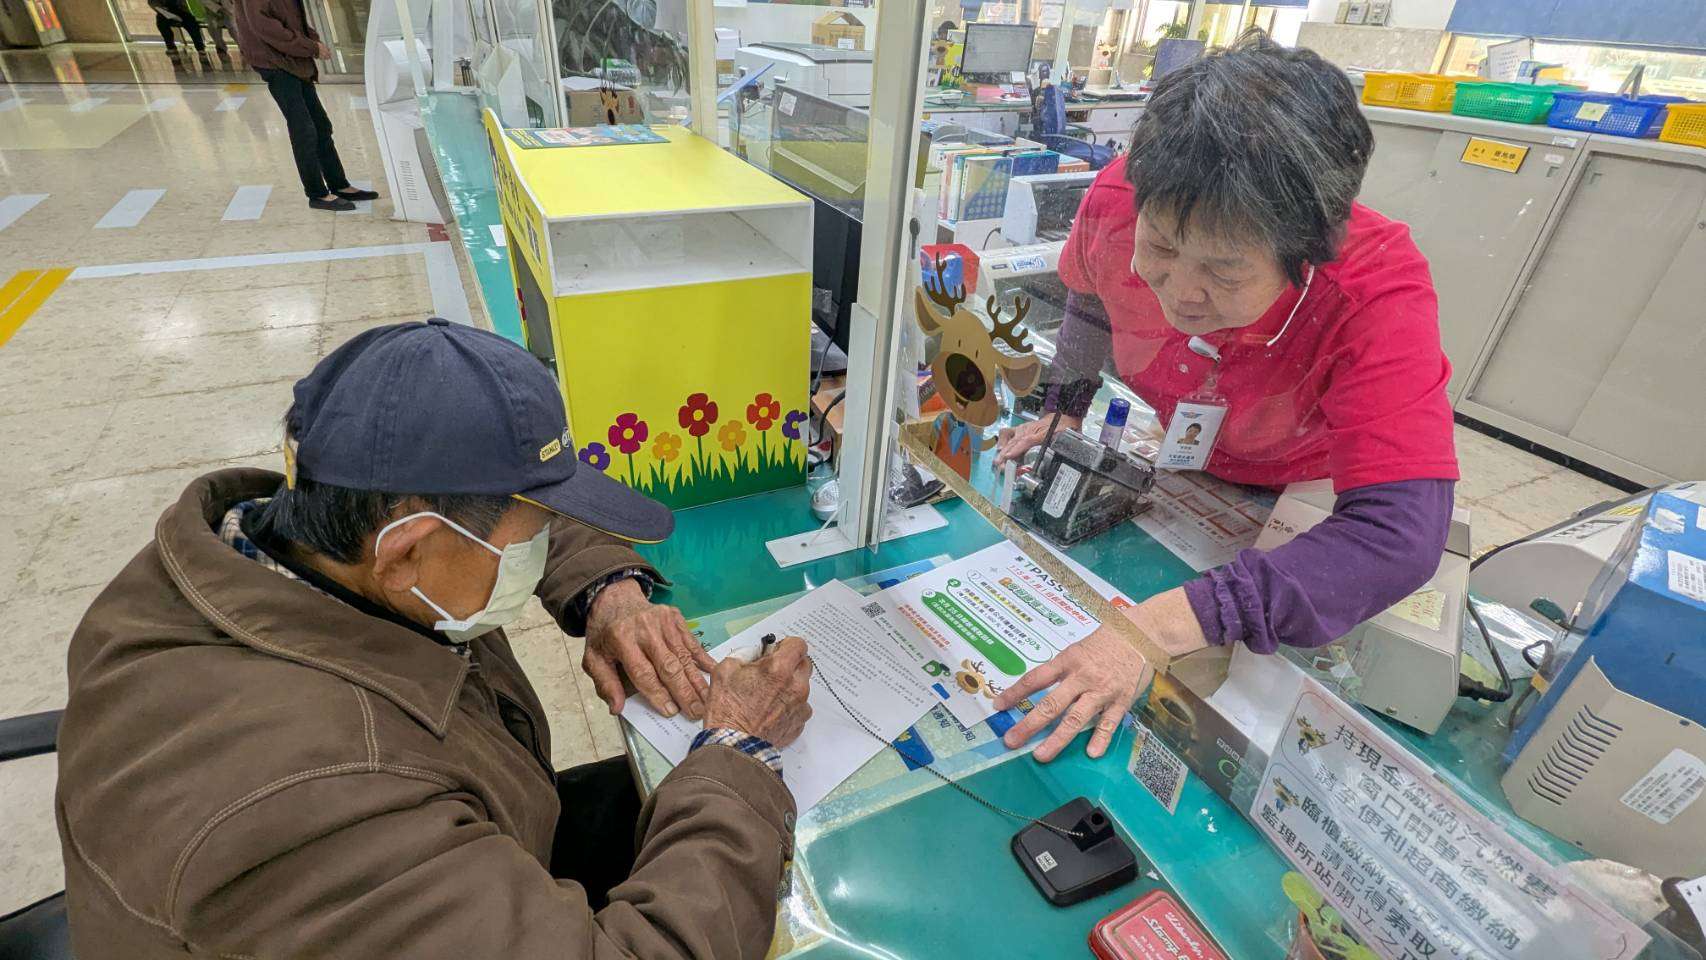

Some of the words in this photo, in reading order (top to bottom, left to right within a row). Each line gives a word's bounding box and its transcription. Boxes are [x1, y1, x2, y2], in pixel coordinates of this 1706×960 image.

[1024, 560, 1064, 592] TPASS
[1313, 762, 1522, 951] 請至便利超商繳納
[1333, 722, 1559, 907] 持現金繳納汽燃費
[1357, 772, 1490, 888] 窗口開單後
[1142, 915, 1181, 957] Stamp
[1320, 841, 1437, 960] 請記得索取
